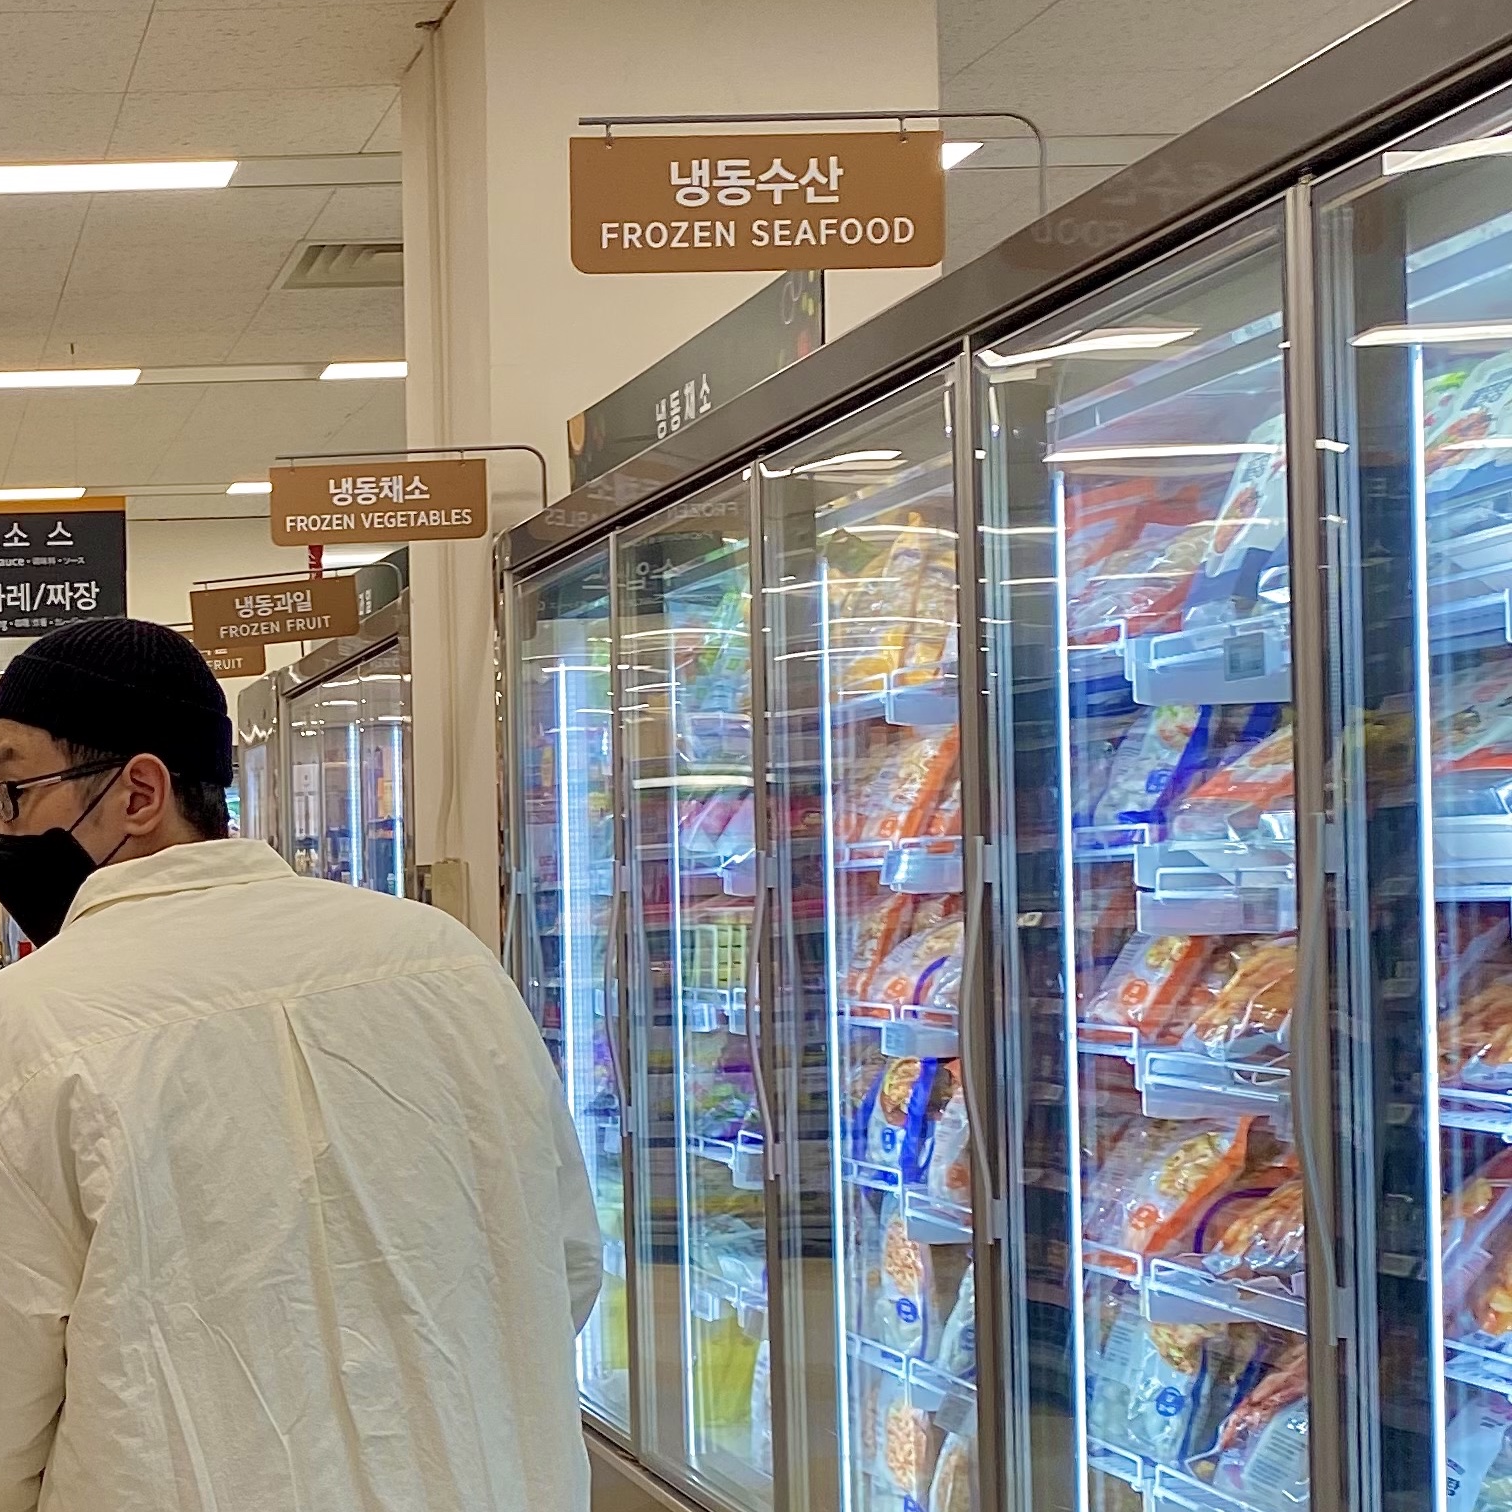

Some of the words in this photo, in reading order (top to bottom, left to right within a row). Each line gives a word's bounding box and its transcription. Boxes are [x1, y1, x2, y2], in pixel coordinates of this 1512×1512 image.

[669, 155, 844, 208] 냉동수산
[600, 220, 737, 249] FROZEN
[751, 216, 916, 248] SEAFOOD
[655, 373, 712, 440] 냉동채소
[329, 474, 431, 507] 냉동채소
[285, 514, 356, 533] FROZEN
[362, 508, 473, 529] VEGETABLES
[235, 589, 313, 619] 냉동과일
[220, 621, 281, 639] FROZEN
[286, 616, 331, 633] FRUIT
